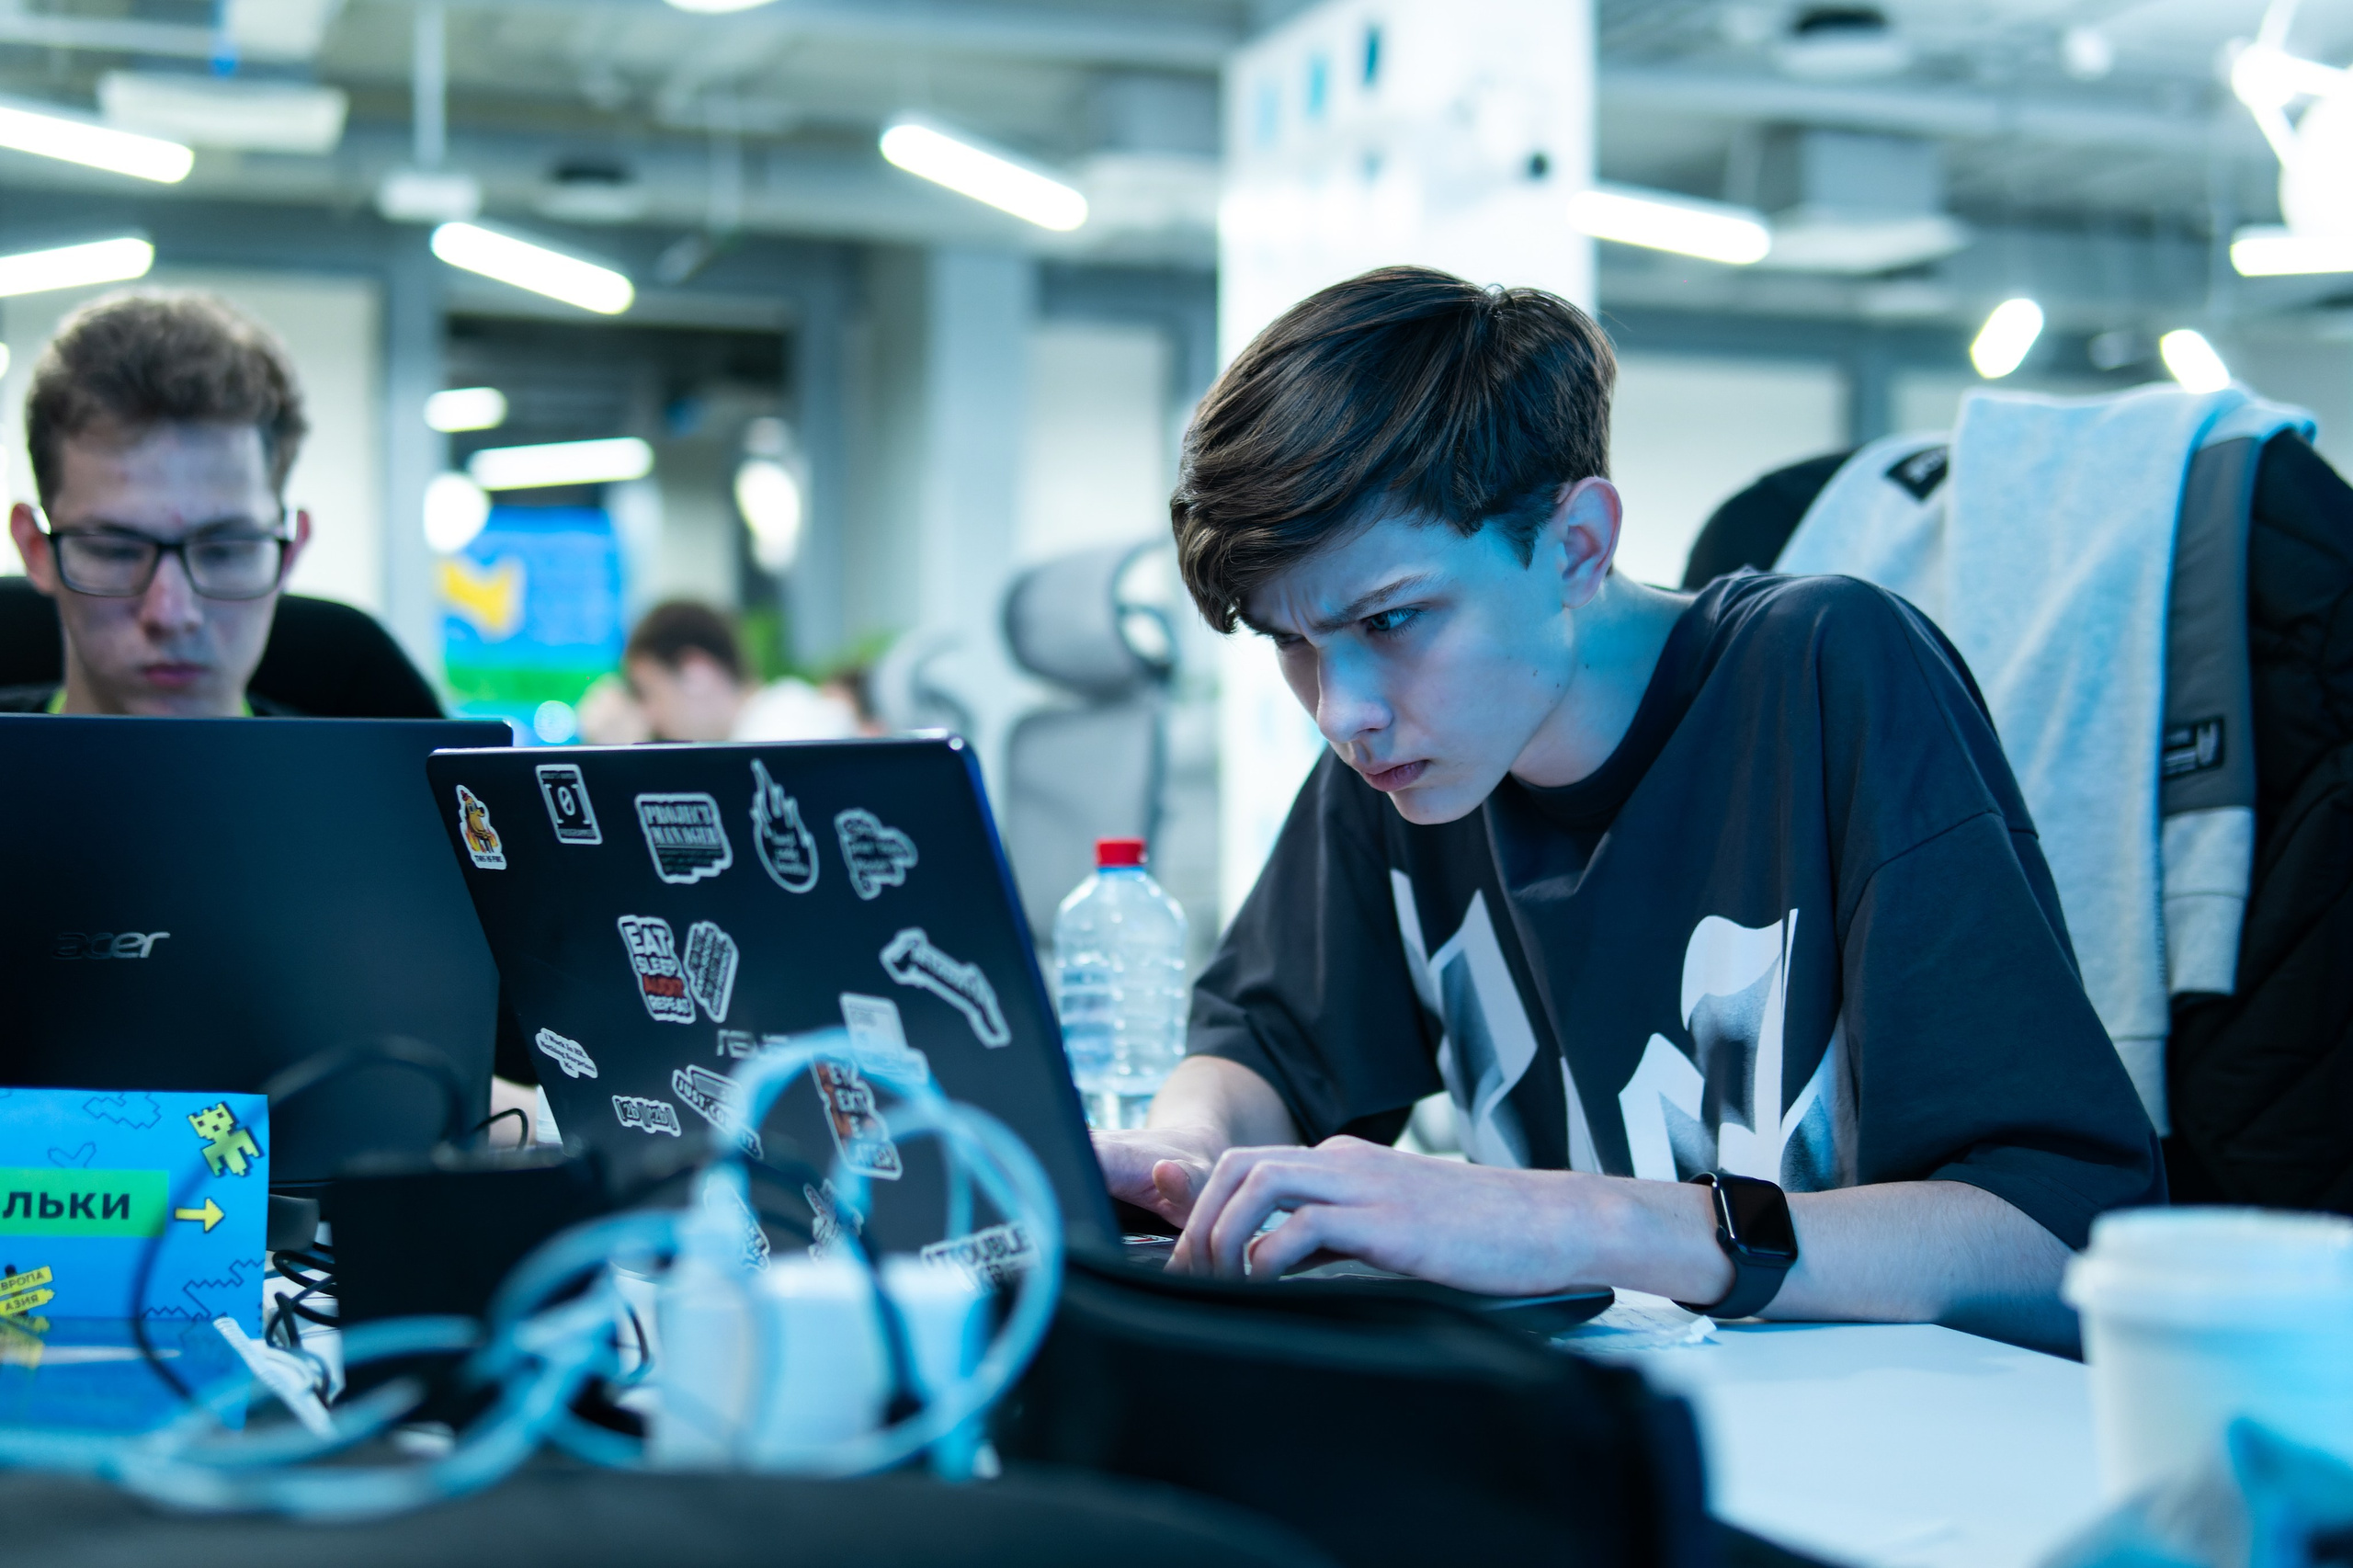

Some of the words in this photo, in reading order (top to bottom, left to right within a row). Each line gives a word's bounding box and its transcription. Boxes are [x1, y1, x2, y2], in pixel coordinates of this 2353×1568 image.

[52, 930, 171, 960] acer
[623, 924, 671, 958] EAT
[677, 1078, 706, 1108] JUST
[5, 1293, 39, 1312] АЗИЯ
